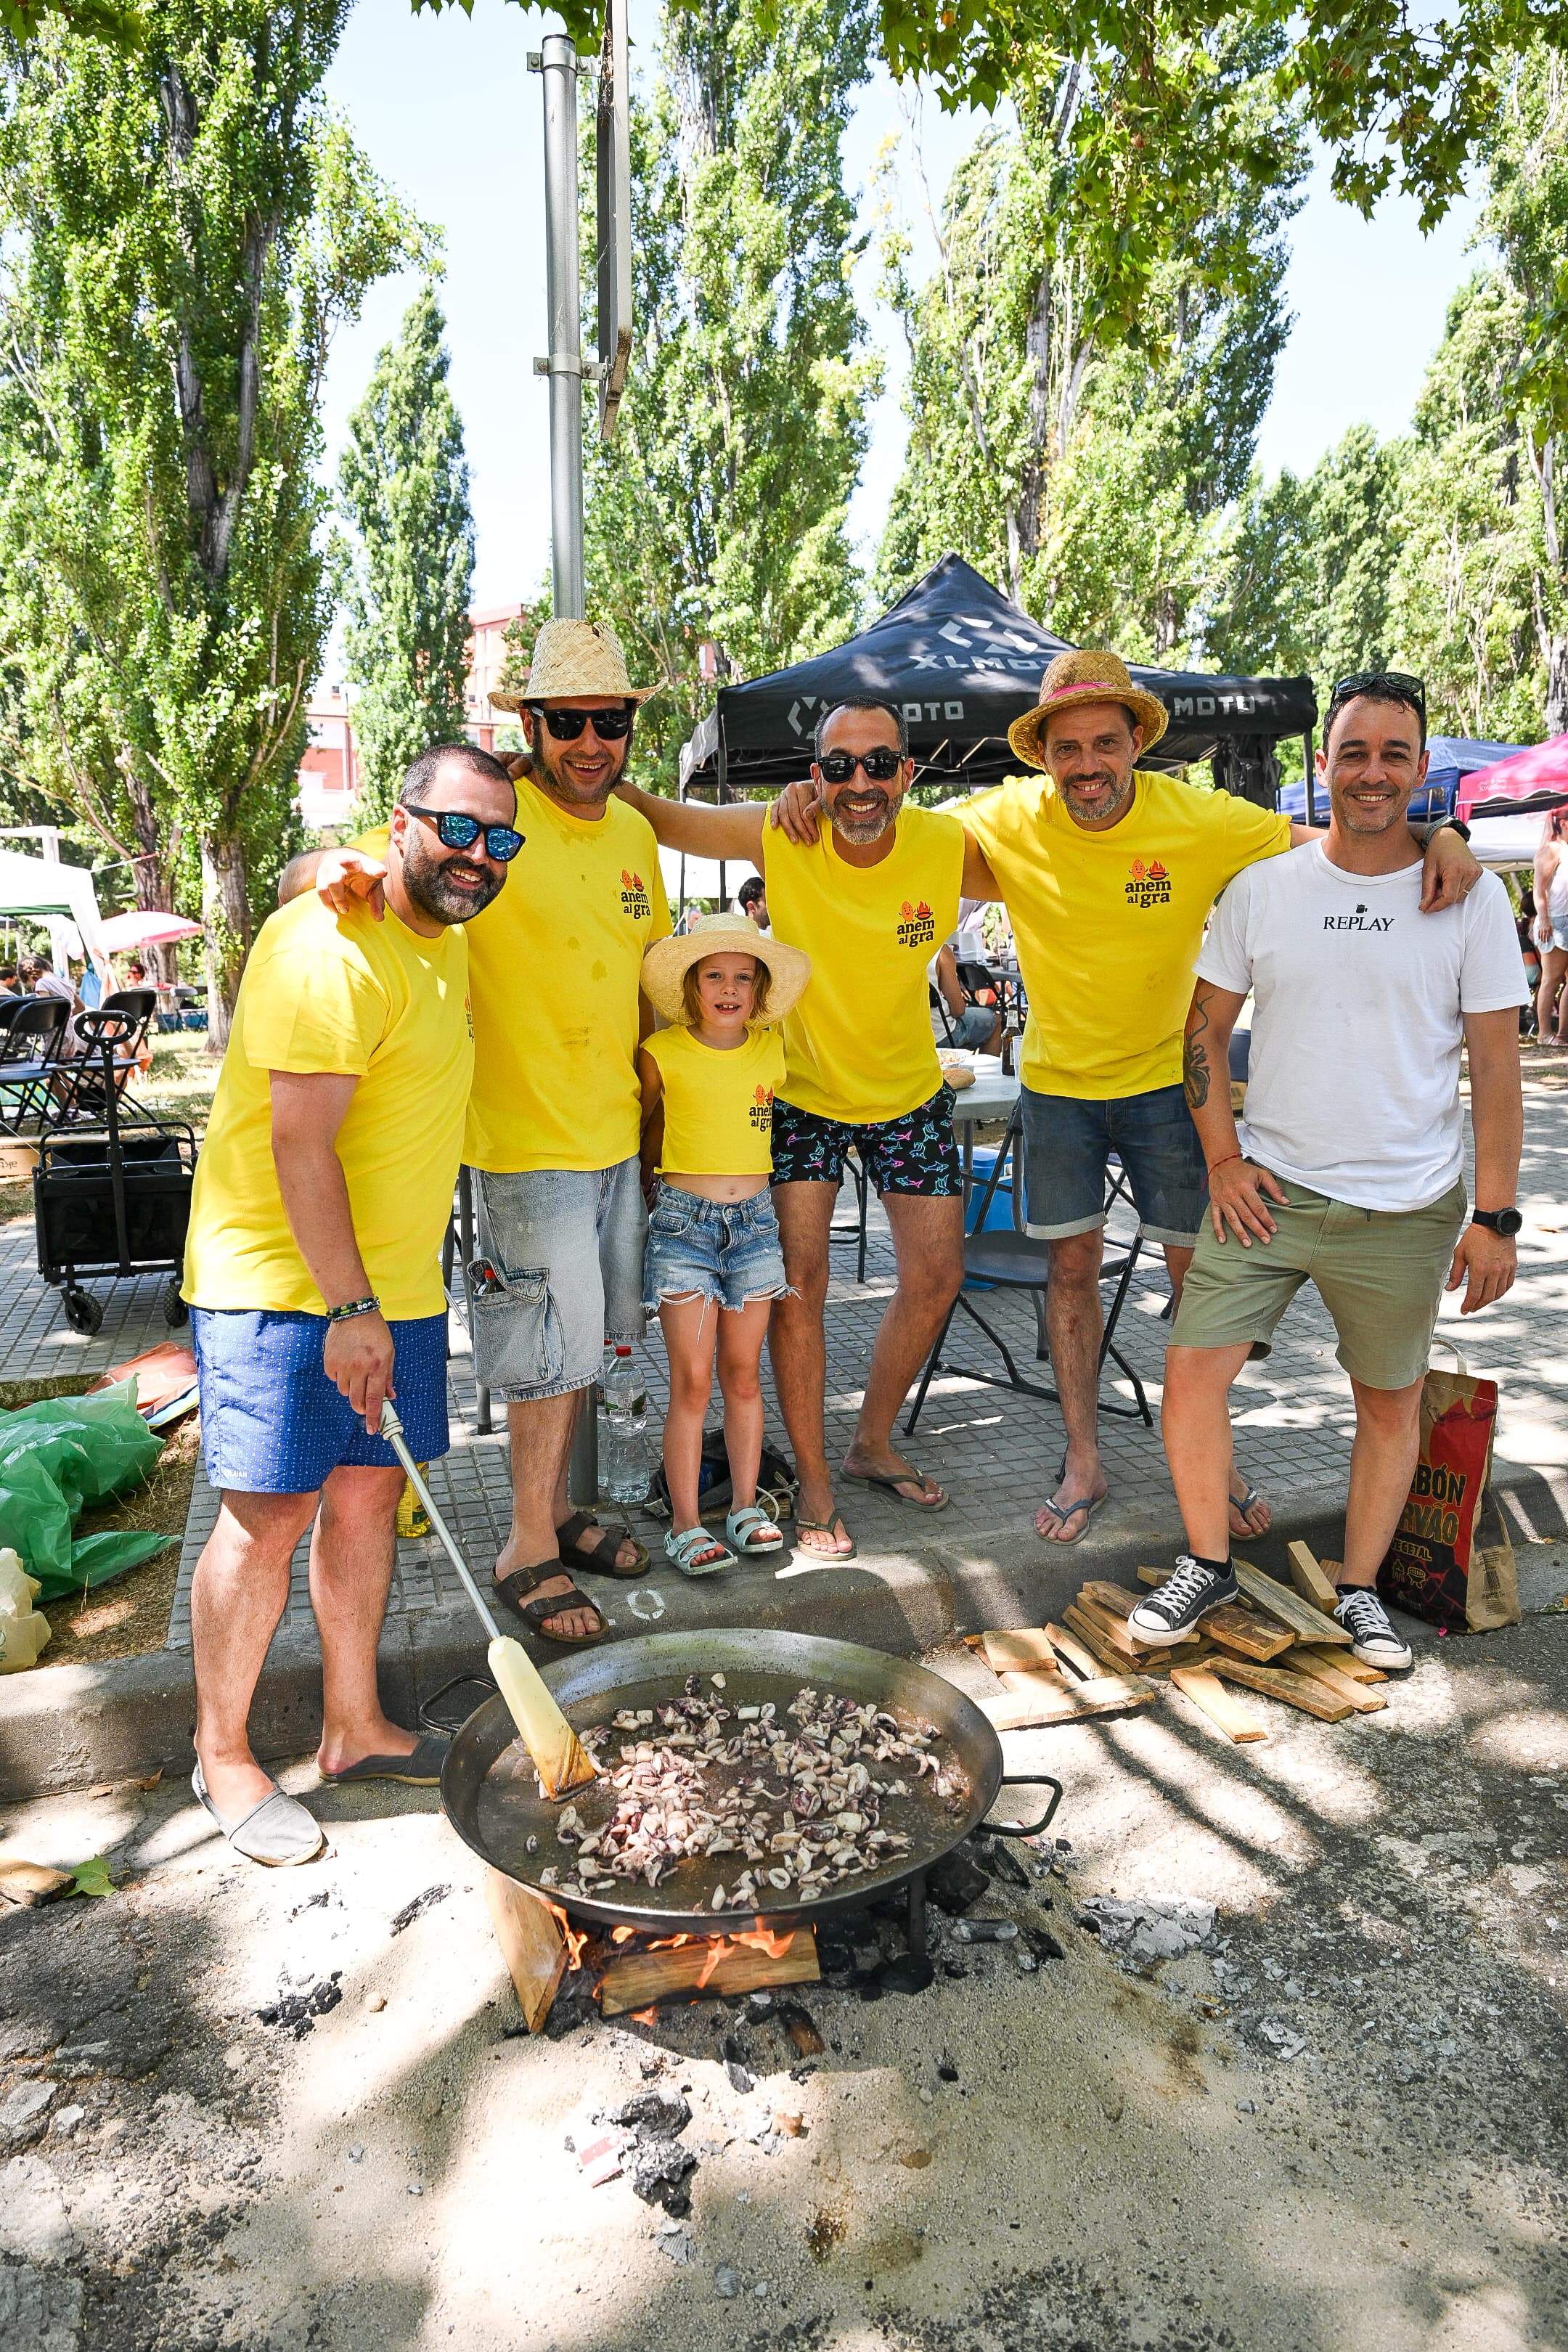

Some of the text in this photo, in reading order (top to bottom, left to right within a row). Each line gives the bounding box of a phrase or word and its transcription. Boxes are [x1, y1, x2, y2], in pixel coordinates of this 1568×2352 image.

[909, 655, 1050, 669] XLMO
[902, 701, 965, 723] OTO
[1124, 880, 1172, 894] anem
[621, 891, 648, 904] anem
[1127, 892, 1171, 909] al gra
[623, 903, 651, 920] al gra
[897, 919, 935, 936] anem
[1322, 915, 1396, 932] REPLAY
[898, 930, 934, 948] al gra
[751, 1116, 759, 1127] al
[1410, 1462, 1467, 1508] BÓN
